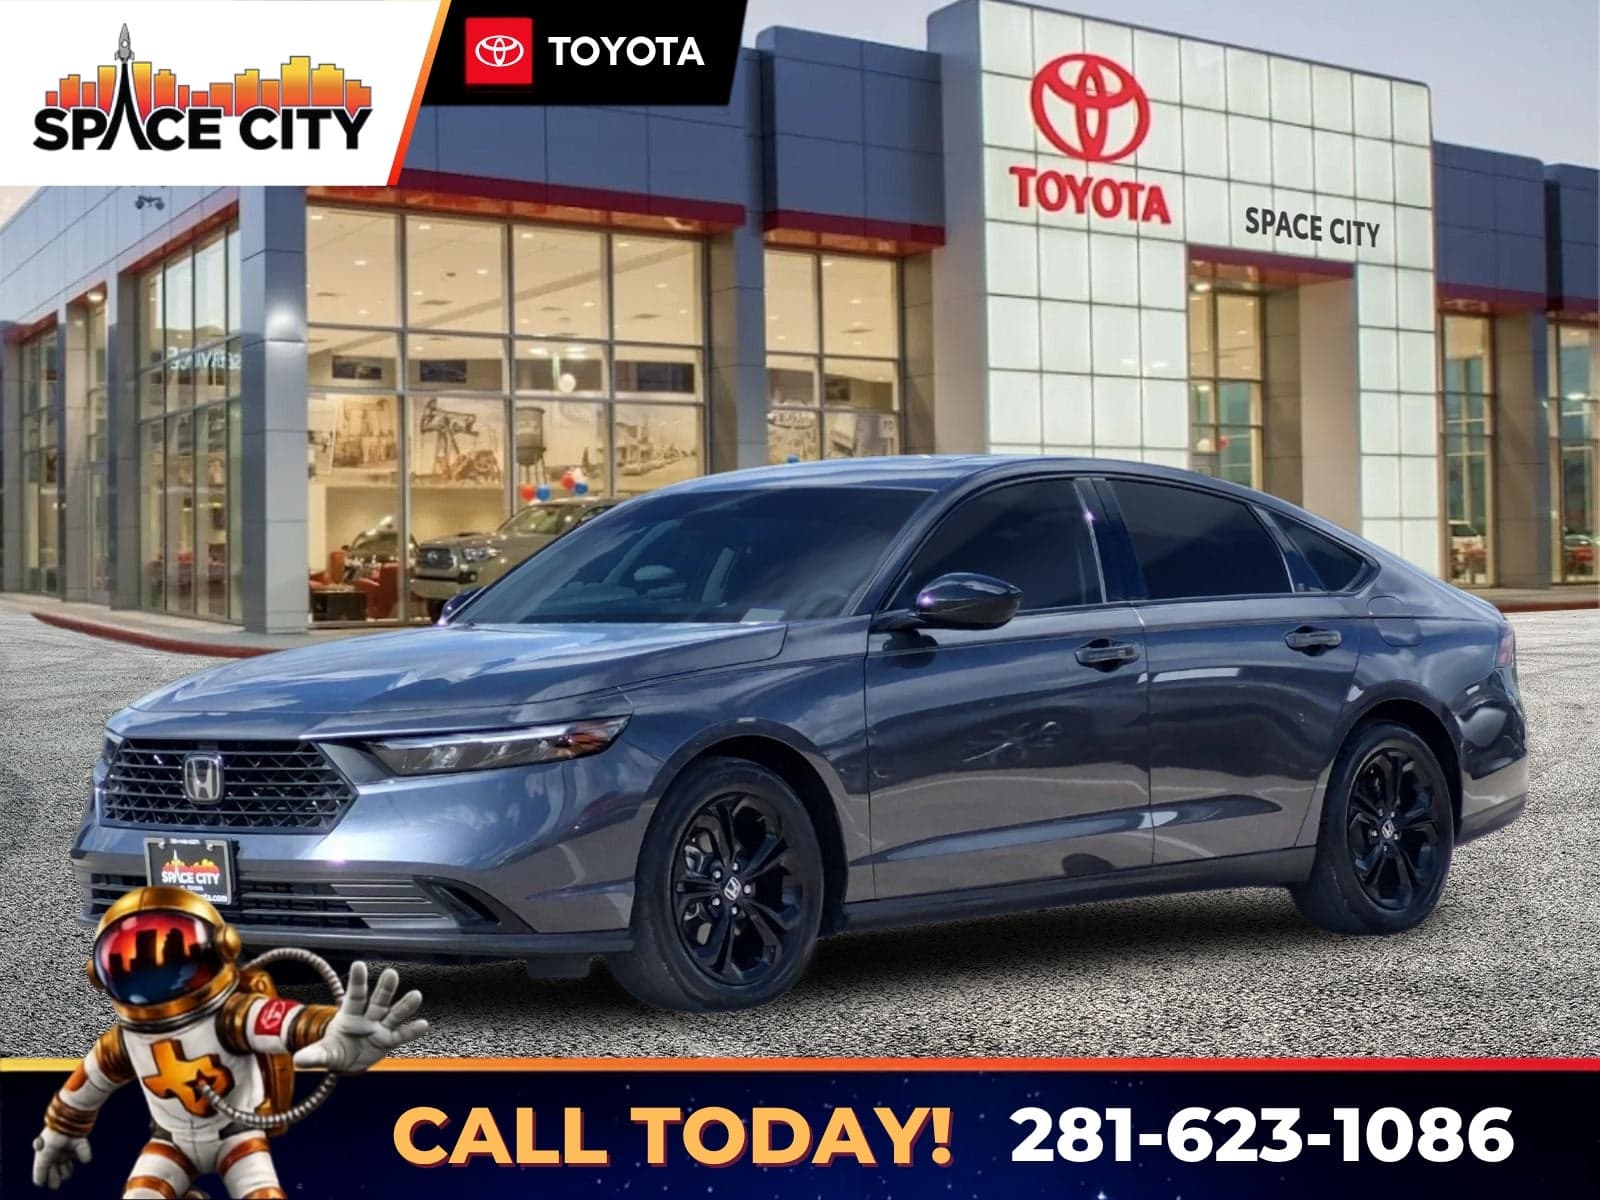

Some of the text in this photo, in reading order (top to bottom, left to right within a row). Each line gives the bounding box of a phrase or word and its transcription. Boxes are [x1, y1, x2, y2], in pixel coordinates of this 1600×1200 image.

[1009, 167, 1171, 224] TOYOTA
[1245, 206, 1381, 248] SPACE CITY
[161, 871, 220, 885] SPACE CITY
